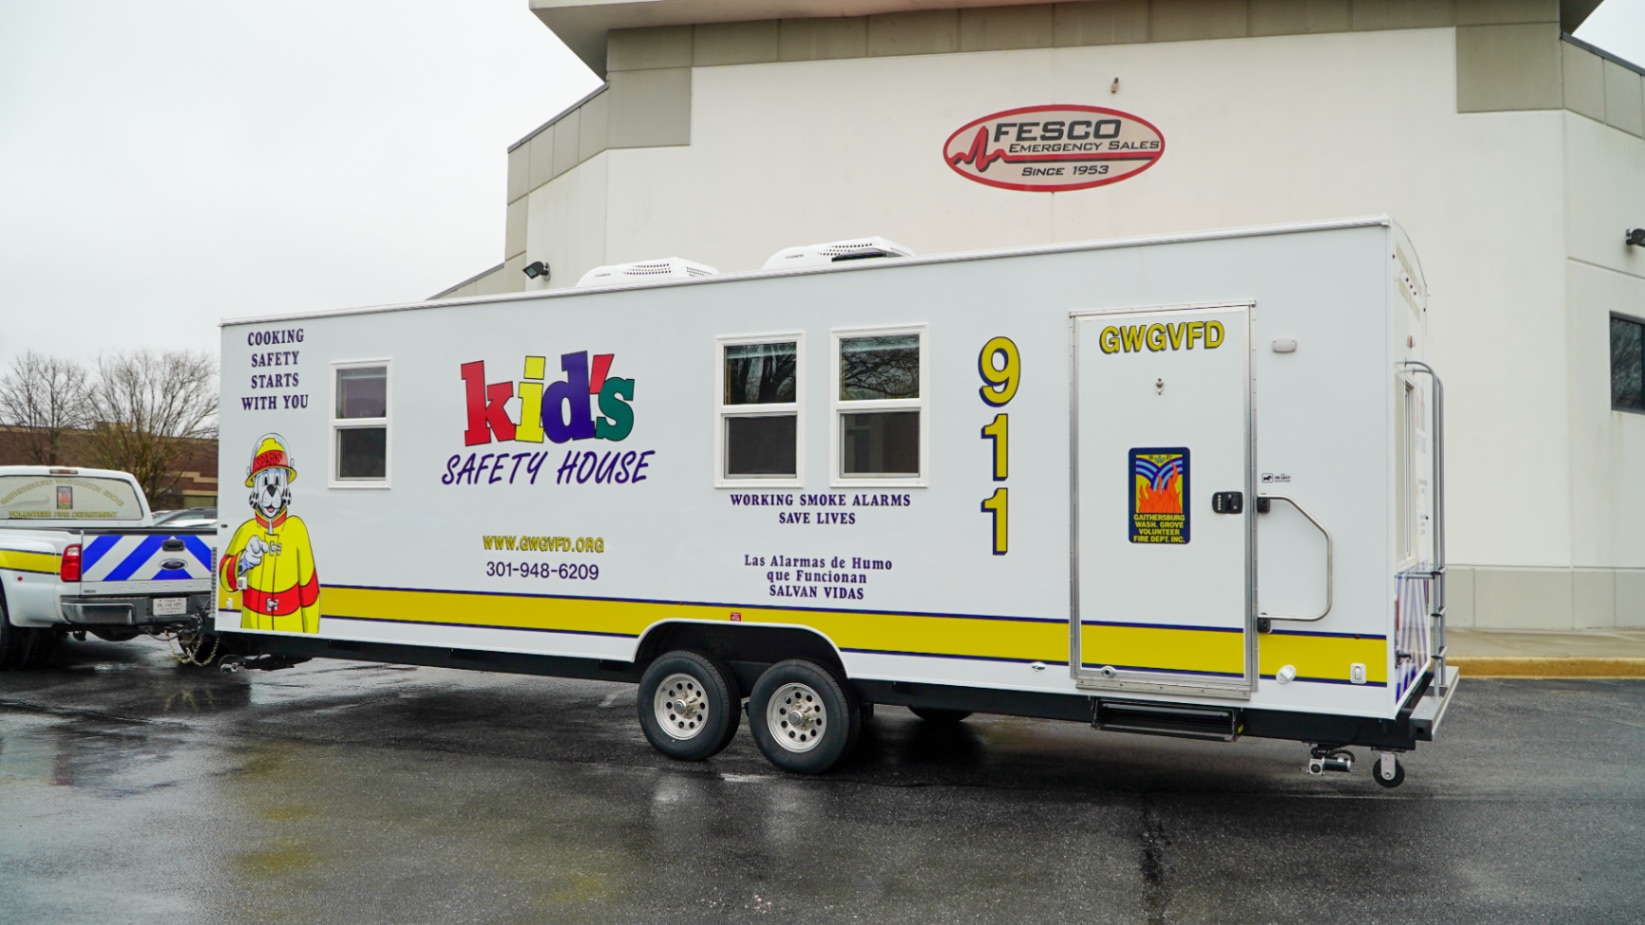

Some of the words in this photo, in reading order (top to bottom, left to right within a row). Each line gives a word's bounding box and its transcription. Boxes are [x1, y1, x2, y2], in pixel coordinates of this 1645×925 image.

[994, 119, 1121, 142] FESCO
[1072, 165, 1109, 175] 1953
[247, 328, 304, 346] COOKING
[1100, 320, 1225, 354] GWGVFD
[251, 350, 299, 368] SAFETY
[251, 372, 299, 389] STARTS
[241, 395, 277, 411] WITH
[282, 394, 309, 409] YOU
[460, 350, 635, 447] kid's
[978, 336, 1021, 556] 911
[441, 450, 549, 485] SAFETY
[556, 450, 656, 484] HOUSE
[730, 494, 794, 506] WORKING
[799, 494, 846, 506] SMOKE
[852, 494, 911, 506] ALARMS
[779, 512, 810, 524] SAVE
[816, 512, 856, 524] LIVES
[483, 536, 605, 553] WWW.GWGVFD.ORG
[486, 561, 599, 580] 301-948-6209
[744, 554, 765, 566] Las
[770, 555, 825, 568] Alarmas
[831, 557, 846, 569] de
[852, 557, 893, 570] Humo
[767, 571, 790, 582] que
[796, 570, 867, 584] Funcionan
[769, 585, 818, 598] SALVAN
[824, 587, 865, 600] VIDAS
